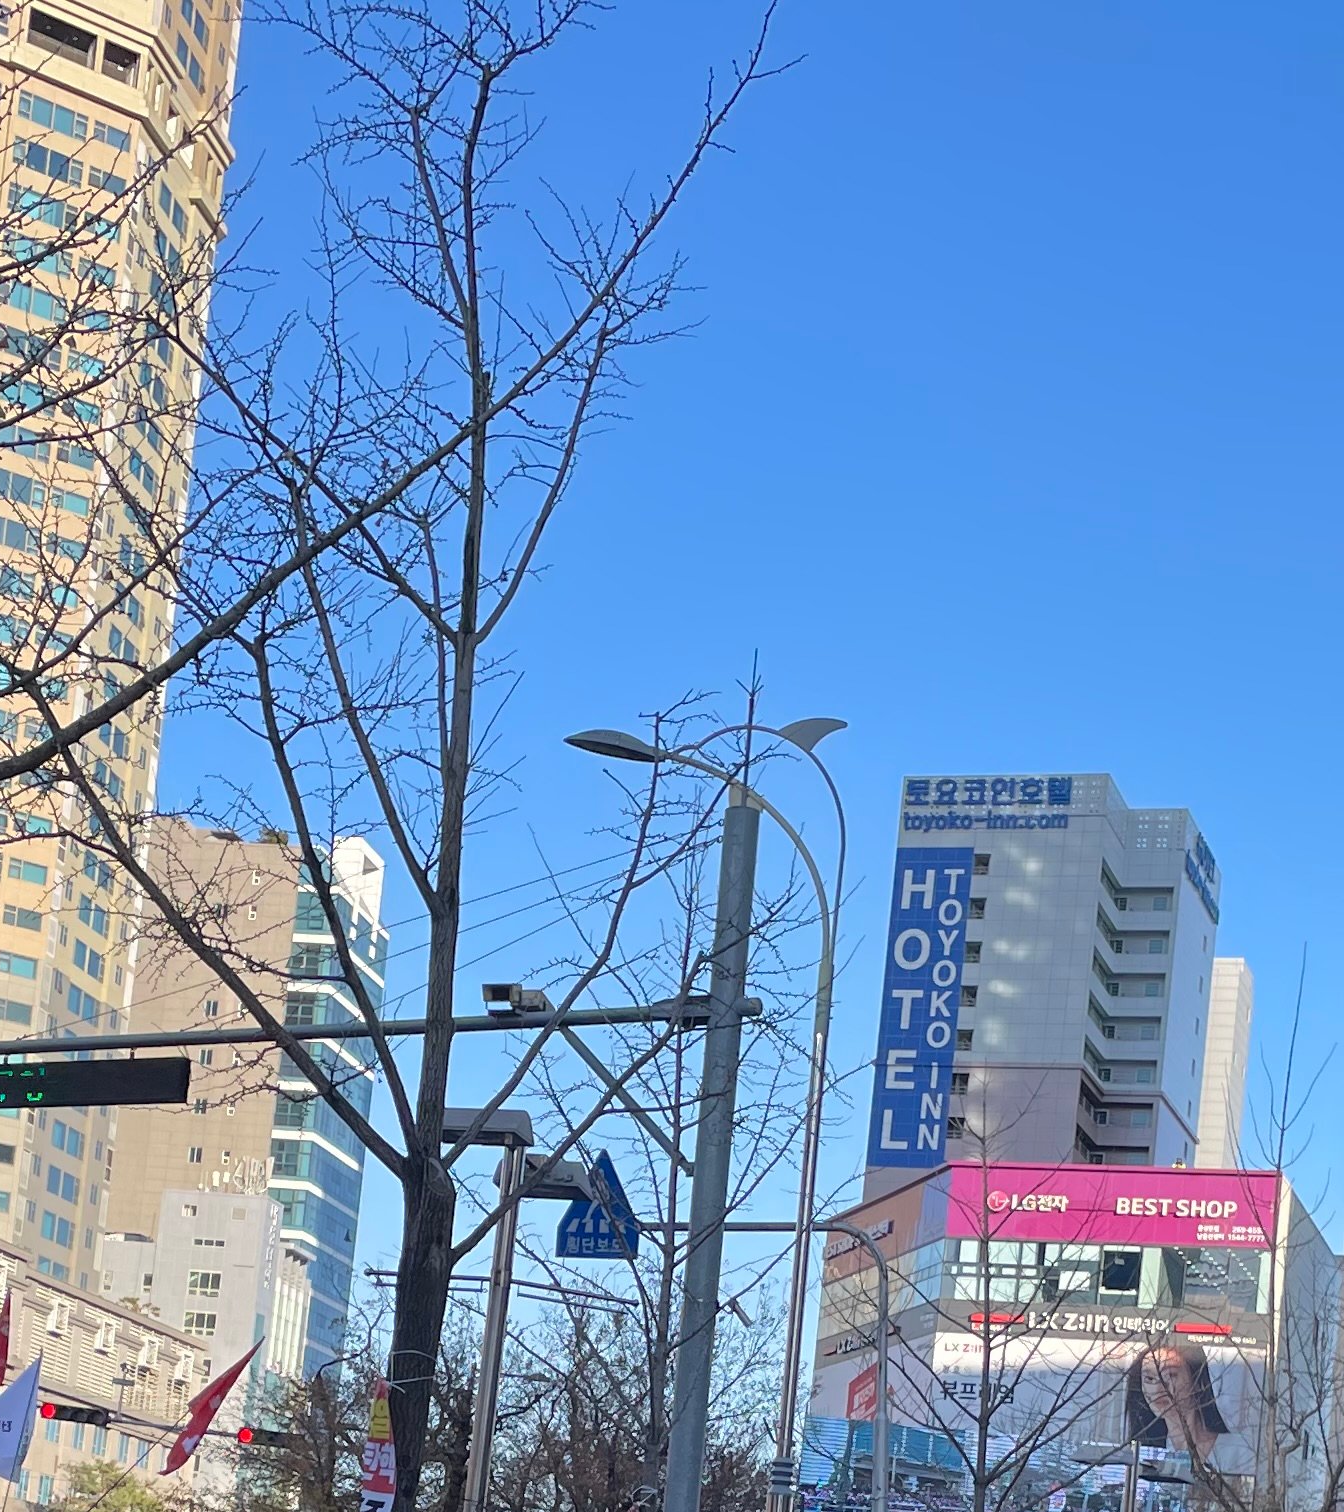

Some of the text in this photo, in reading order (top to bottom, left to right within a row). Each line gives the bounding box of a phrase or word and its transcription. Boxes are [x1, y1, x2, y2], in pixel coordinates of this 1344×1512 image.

[905, 777, 1073, 806] 토요코인호텔
[879, 868, 935, 1152] HOTEL
[916, 868, 965, 1152] TOYOKO INN
[1115, 1197, 1238, 1218] BEST SHOP
[1112, 1315, 1171, 1335] 인테리어
